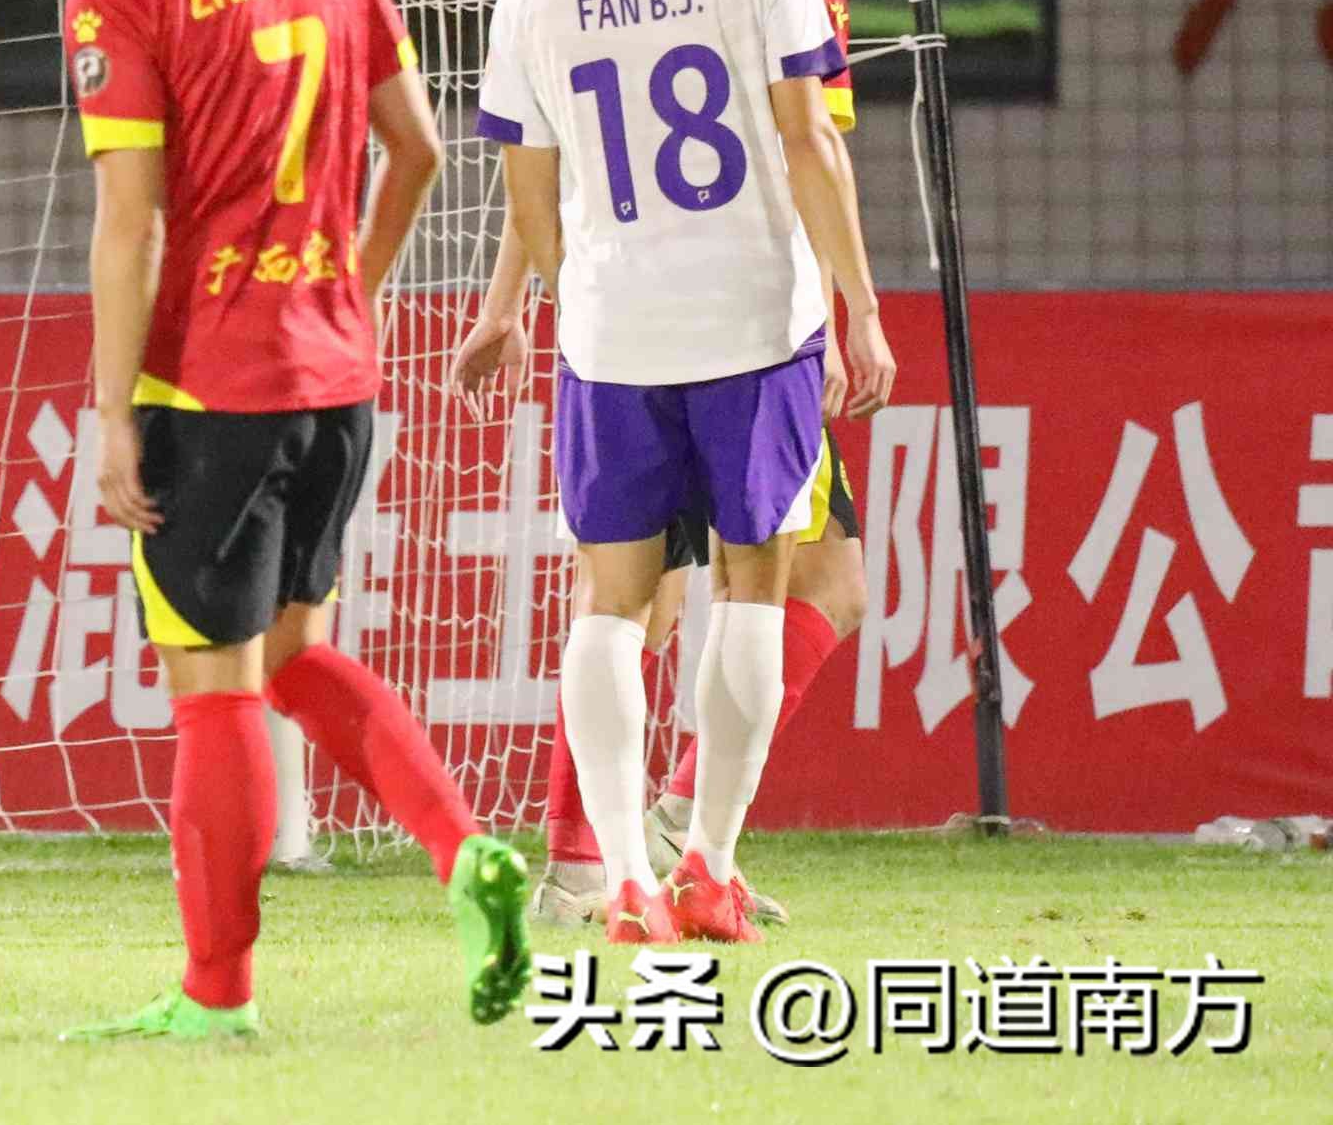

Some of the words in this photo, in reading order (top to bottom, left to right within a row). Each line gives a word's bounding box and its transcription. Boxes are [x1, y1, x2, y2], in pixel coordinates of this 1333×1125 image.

[251, 15, 327, 204] 7
[569, 43, 748, 224] 18
[205, 230, 358, 296] 广西宝
